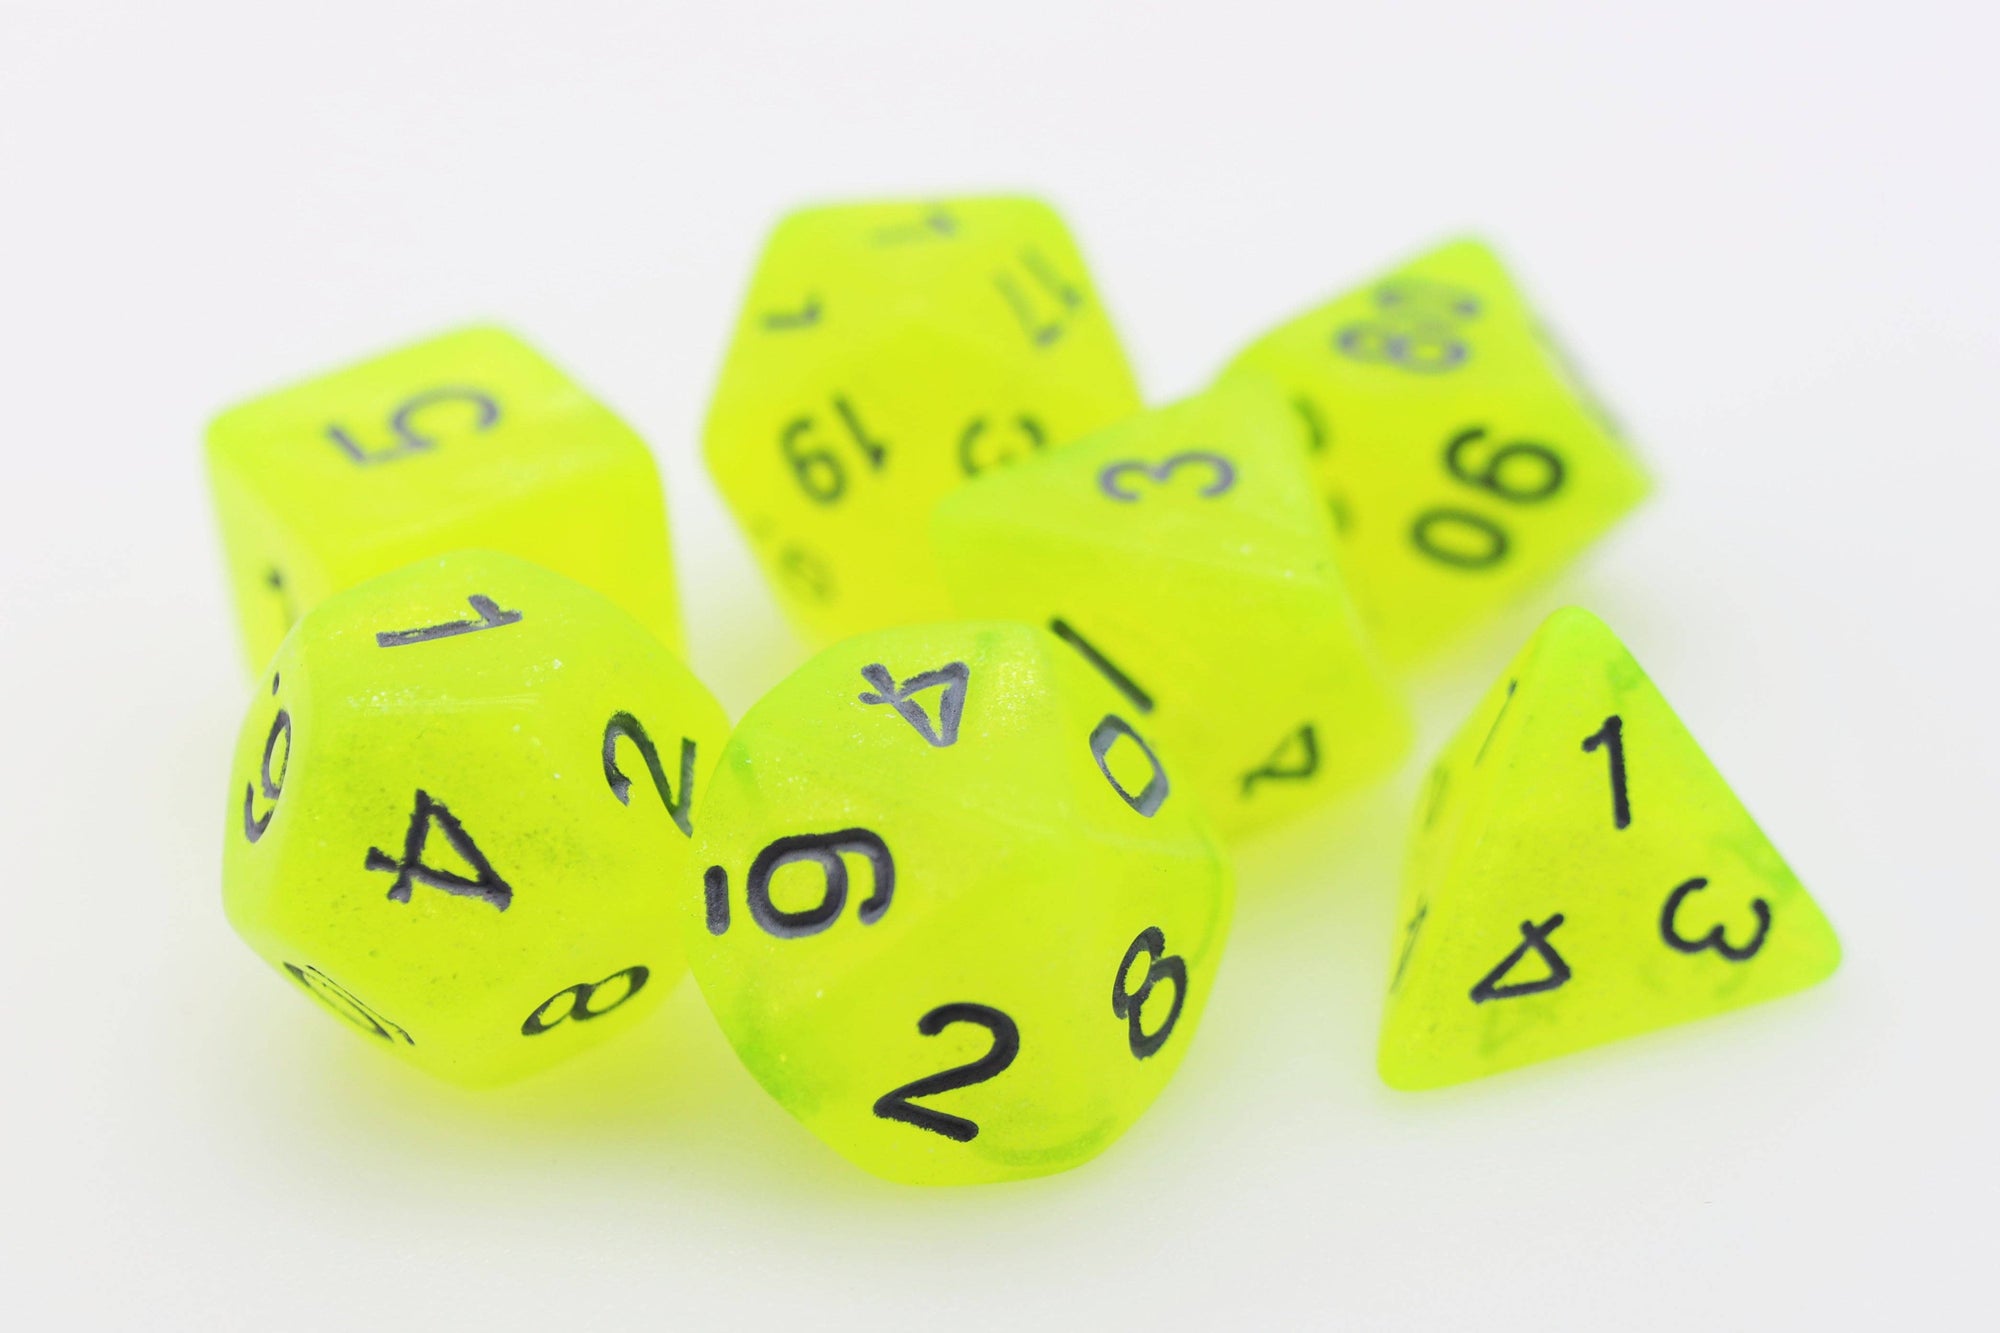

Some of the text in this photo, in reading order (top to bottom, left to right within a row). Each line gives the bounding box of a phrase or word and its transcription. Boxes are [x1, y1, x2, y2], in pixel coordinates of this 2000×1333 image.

[325, 388, 501, 467] 5
[780, 396, 888, 504] 19
[1097, 451, 1236, 503] 3
[376, 595, 522, 647] 1
[858, 663, 969, 746] 4
[602, 711, 696, 838] 2
[1582, 715, 1631, 830] 1
[365, 789, 513, 912] 4
[1470, 913, 1571, 1004] 4
[1659, 877, 1772, 962] 3
[521, 966, 649, 1036] 8
[1112, 926, 1188, 1060] 8
[873, 1003, 1020, 1142] 2
